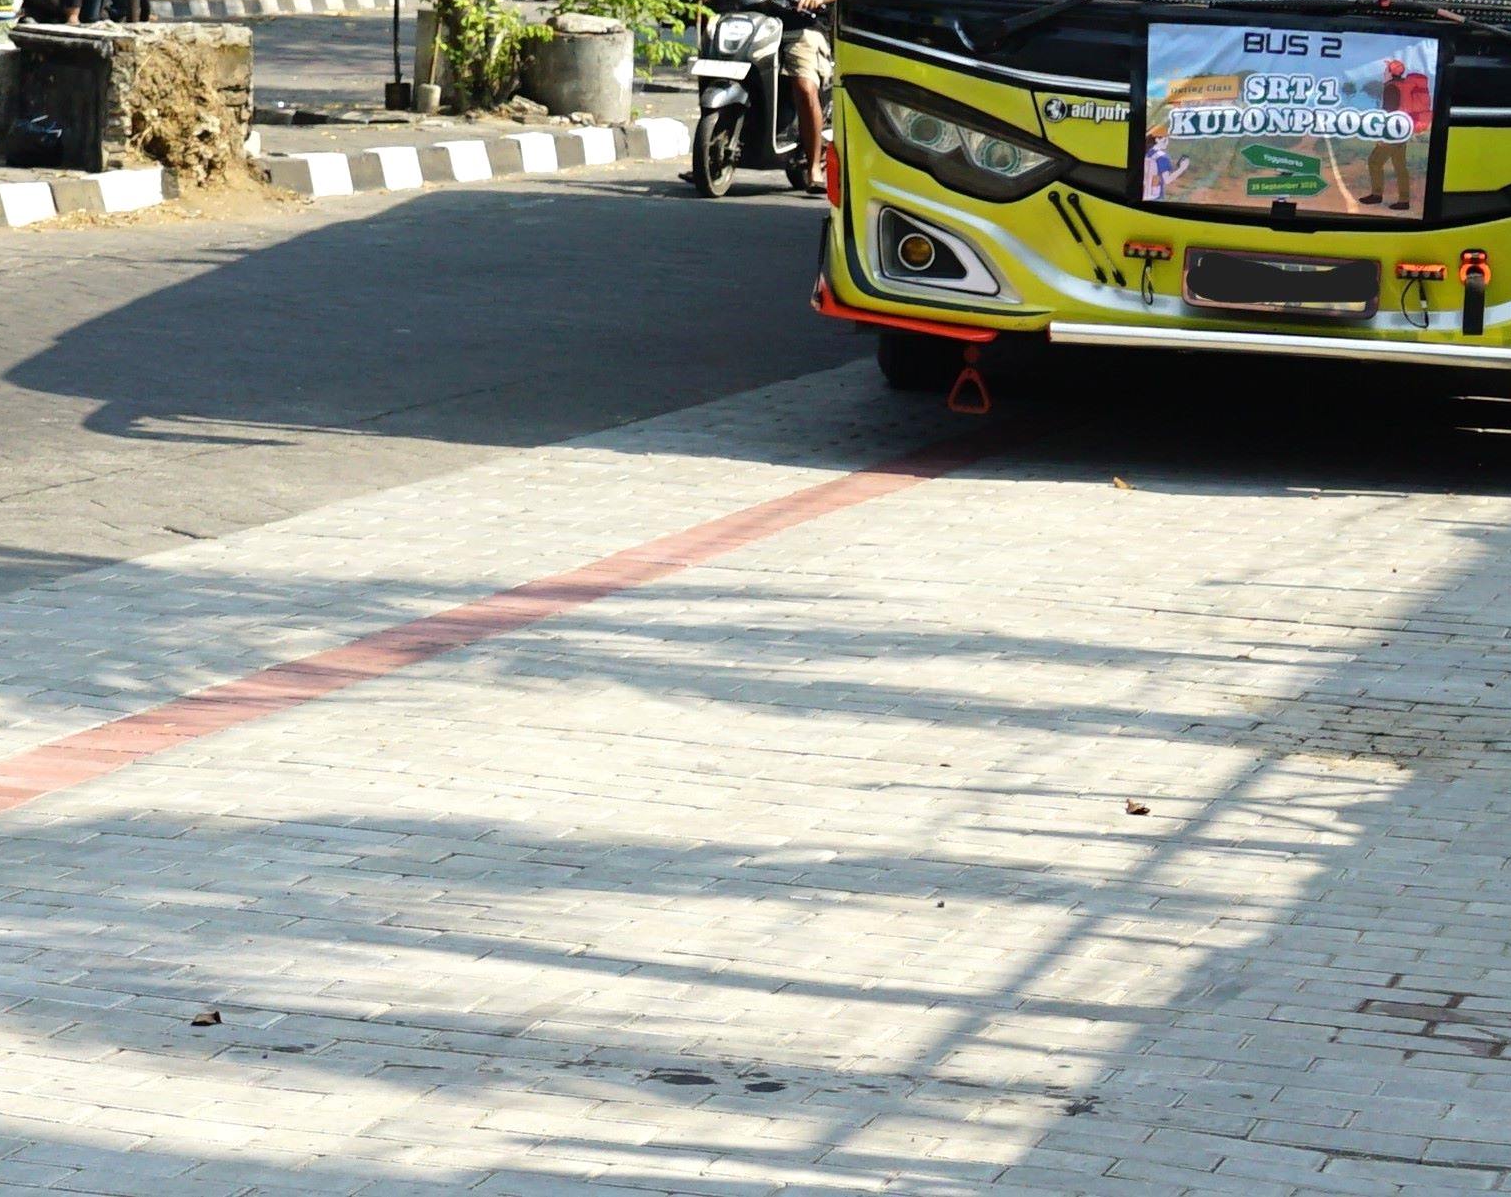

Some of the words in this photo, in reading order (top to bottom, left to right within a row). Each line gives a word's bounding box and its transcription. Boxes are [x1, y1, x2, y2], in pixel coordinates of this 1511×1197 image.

[1243, 32, 1309, 56] BUS
[1321, 37, 1342, 59] 2
[1245, 74, 1313, 105] SRT
[1316, 77, 1341, 106] 1
[1071, 101, 1130, 124] adiputr
[1170, 107, 1413, 141] KULONPROGO
